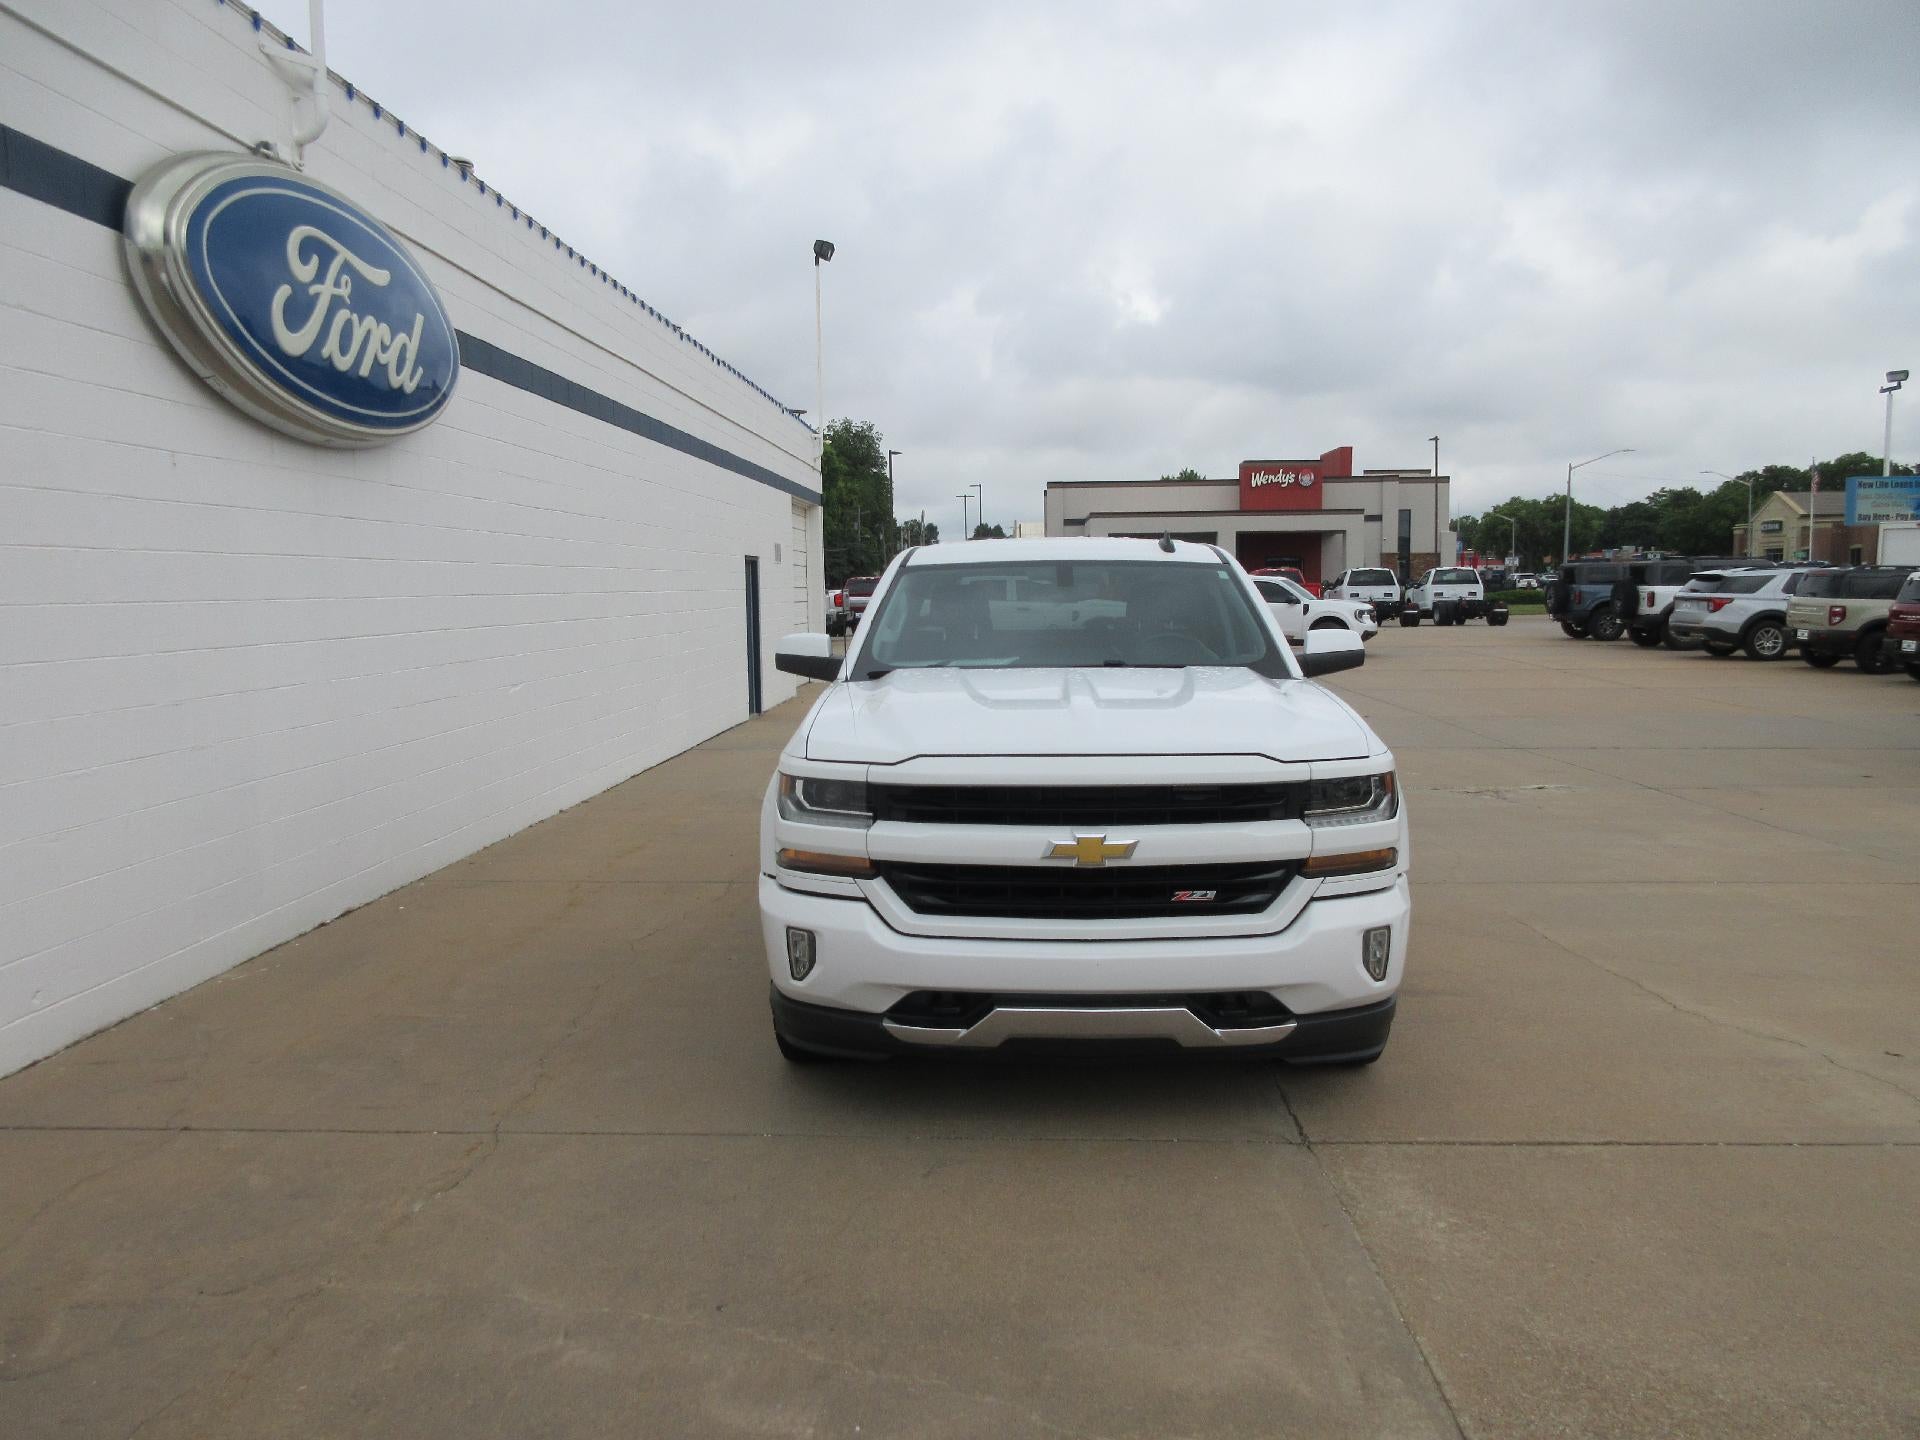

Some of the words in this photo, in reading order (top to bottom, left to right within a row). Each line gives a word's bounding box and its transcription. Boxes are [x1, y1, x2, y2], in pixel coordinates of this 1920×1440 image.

[271, 225, 424, 394] Ford
[1251, 469, 1296, 488] Wendy's
[1170, 890, 1217, 901] Z71
